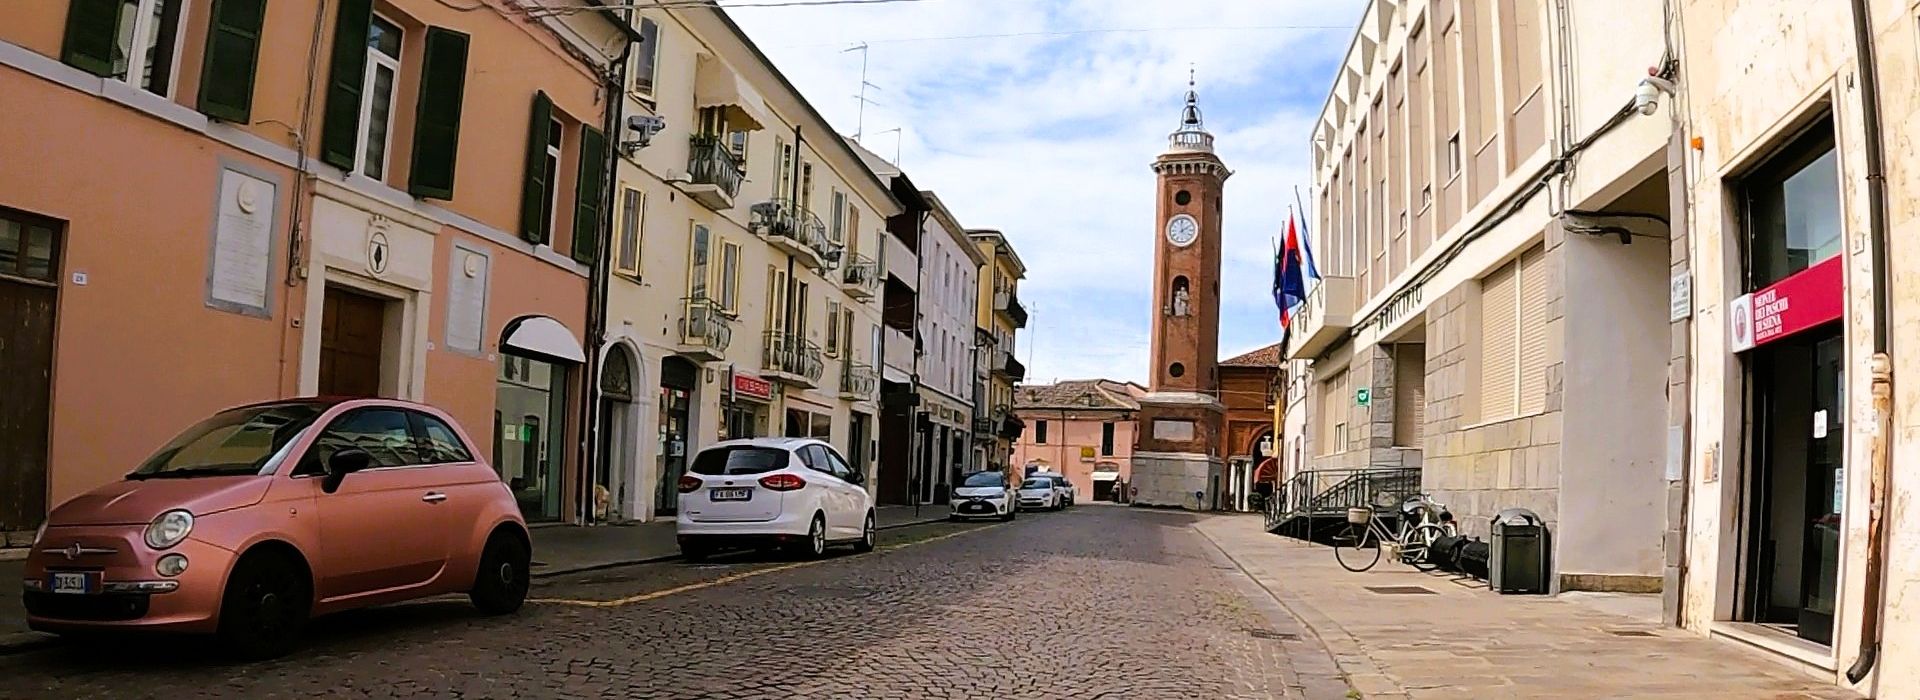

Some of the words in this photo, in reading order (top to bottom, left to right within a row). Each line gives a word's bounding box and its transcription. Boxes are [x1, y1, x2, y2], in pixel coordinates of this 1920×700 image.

[1754, 289, 1776, 308] MONTE
[1755, 306, 1765, 320] DEI
[1765, 297, 1789, 316] PASCHI
[1763, 314, 1782, 329] SIENA
